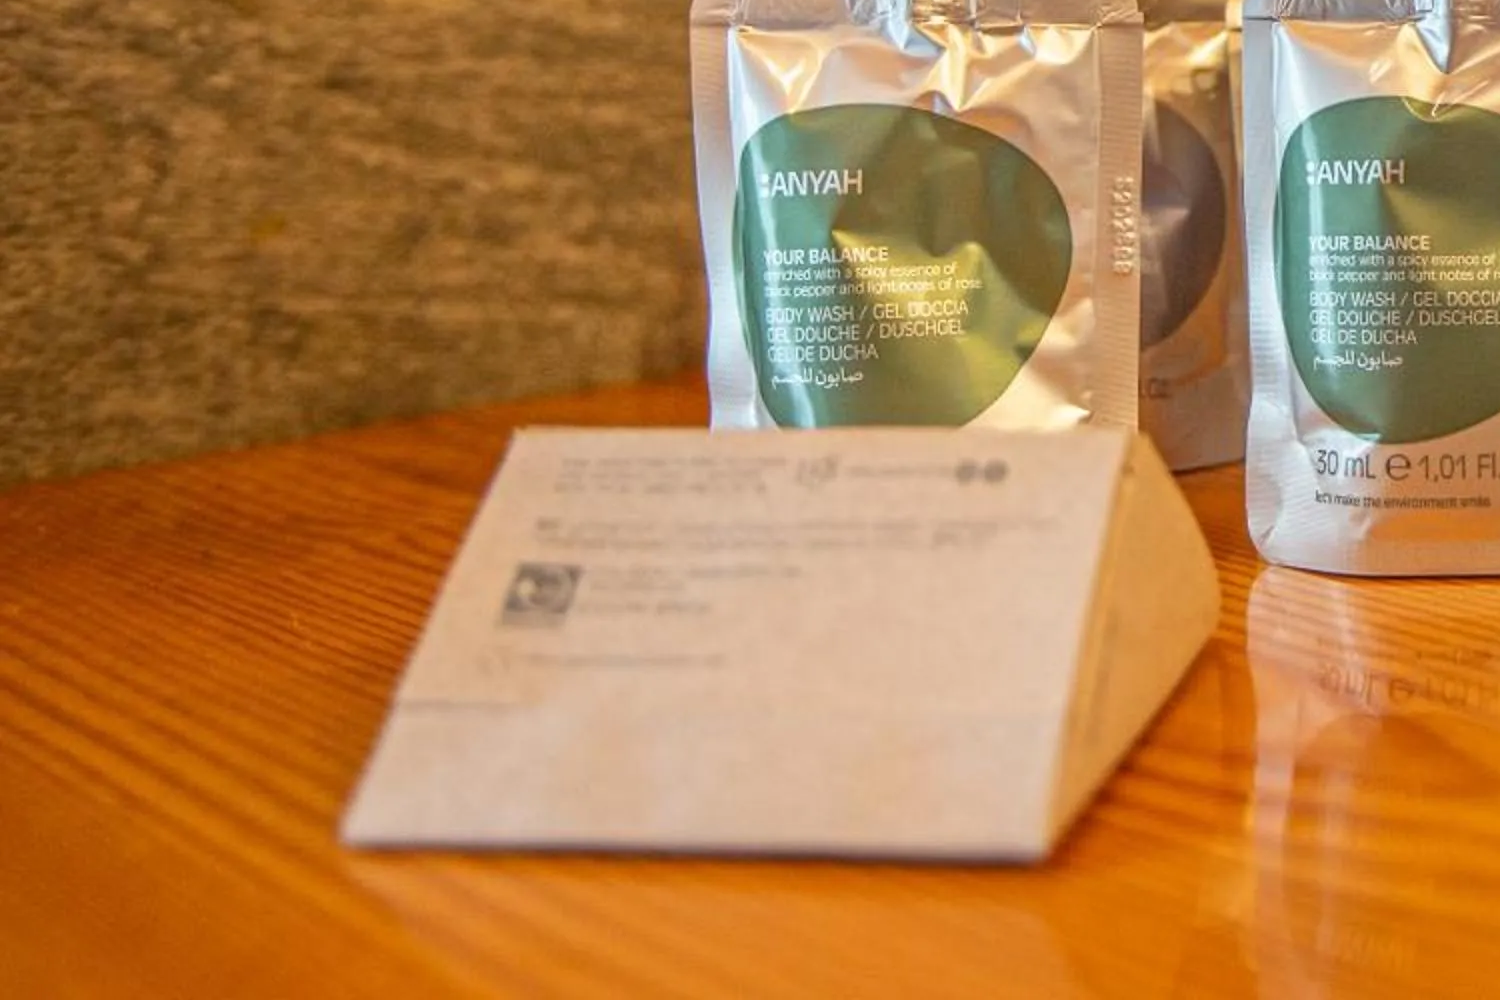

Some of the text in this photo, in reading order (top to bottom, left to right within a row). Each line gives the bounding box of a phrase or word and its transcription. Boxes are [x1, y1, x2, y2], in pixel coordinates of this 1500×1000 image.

[1309, 235, 1431, 251] YOUR BALANCE
[764, 247, 889, 265] YOUR BALANCE
[1359, 253, 1384, 266] with
[1397, 253, 1430, 268] spicy
[1482, 252, 1497, 266] of
[814, 266, 841, 280] with
[855, 265, 887, 280] spicy
[943, 261, 958, 275] of
[1338, 271, 1379, 284] pepper
[1382, 269, 1405, 281] and
[1439, 270, 1475, 281] notes
[1477, 268, 1492, 281] of
[839, 281, 864, 295] and
[938, 276, 953, 291] of
[1310, 291, 1348, 307] BODY
[1351, 291, 1395, 307] WASH
[1413, 291, 1442, 307] GEL
[765, 306, 804, 324] BODY
[807, 305, 854, 323] WASH
[873, 303, 904, 320] GEL
[908, 300, 969, 318] DOCCIA
[1310, 310, 1335, 326] GEL
[1337, 310, 1400, 326] DOUCHE
[767, 326, 793, 343] GEL
[795, 324, 860, 343] DOUCHE
[879, 319, 966, 339] DUSCHGEL
[1311, 329, 1419, 345] GEL DE DUCHA
[767, 343, 880, 364] GEL DE DUCHA
[1357, 350, 1404, 371] صابون
[814, 367, 864, 388] صابون
[1316, 449, 1339, 476] 30
[1344, 454, 1376, 479] mL
[1417, 454, 1467, 483] 1,01
[1363, 494, 1382, 507] the
